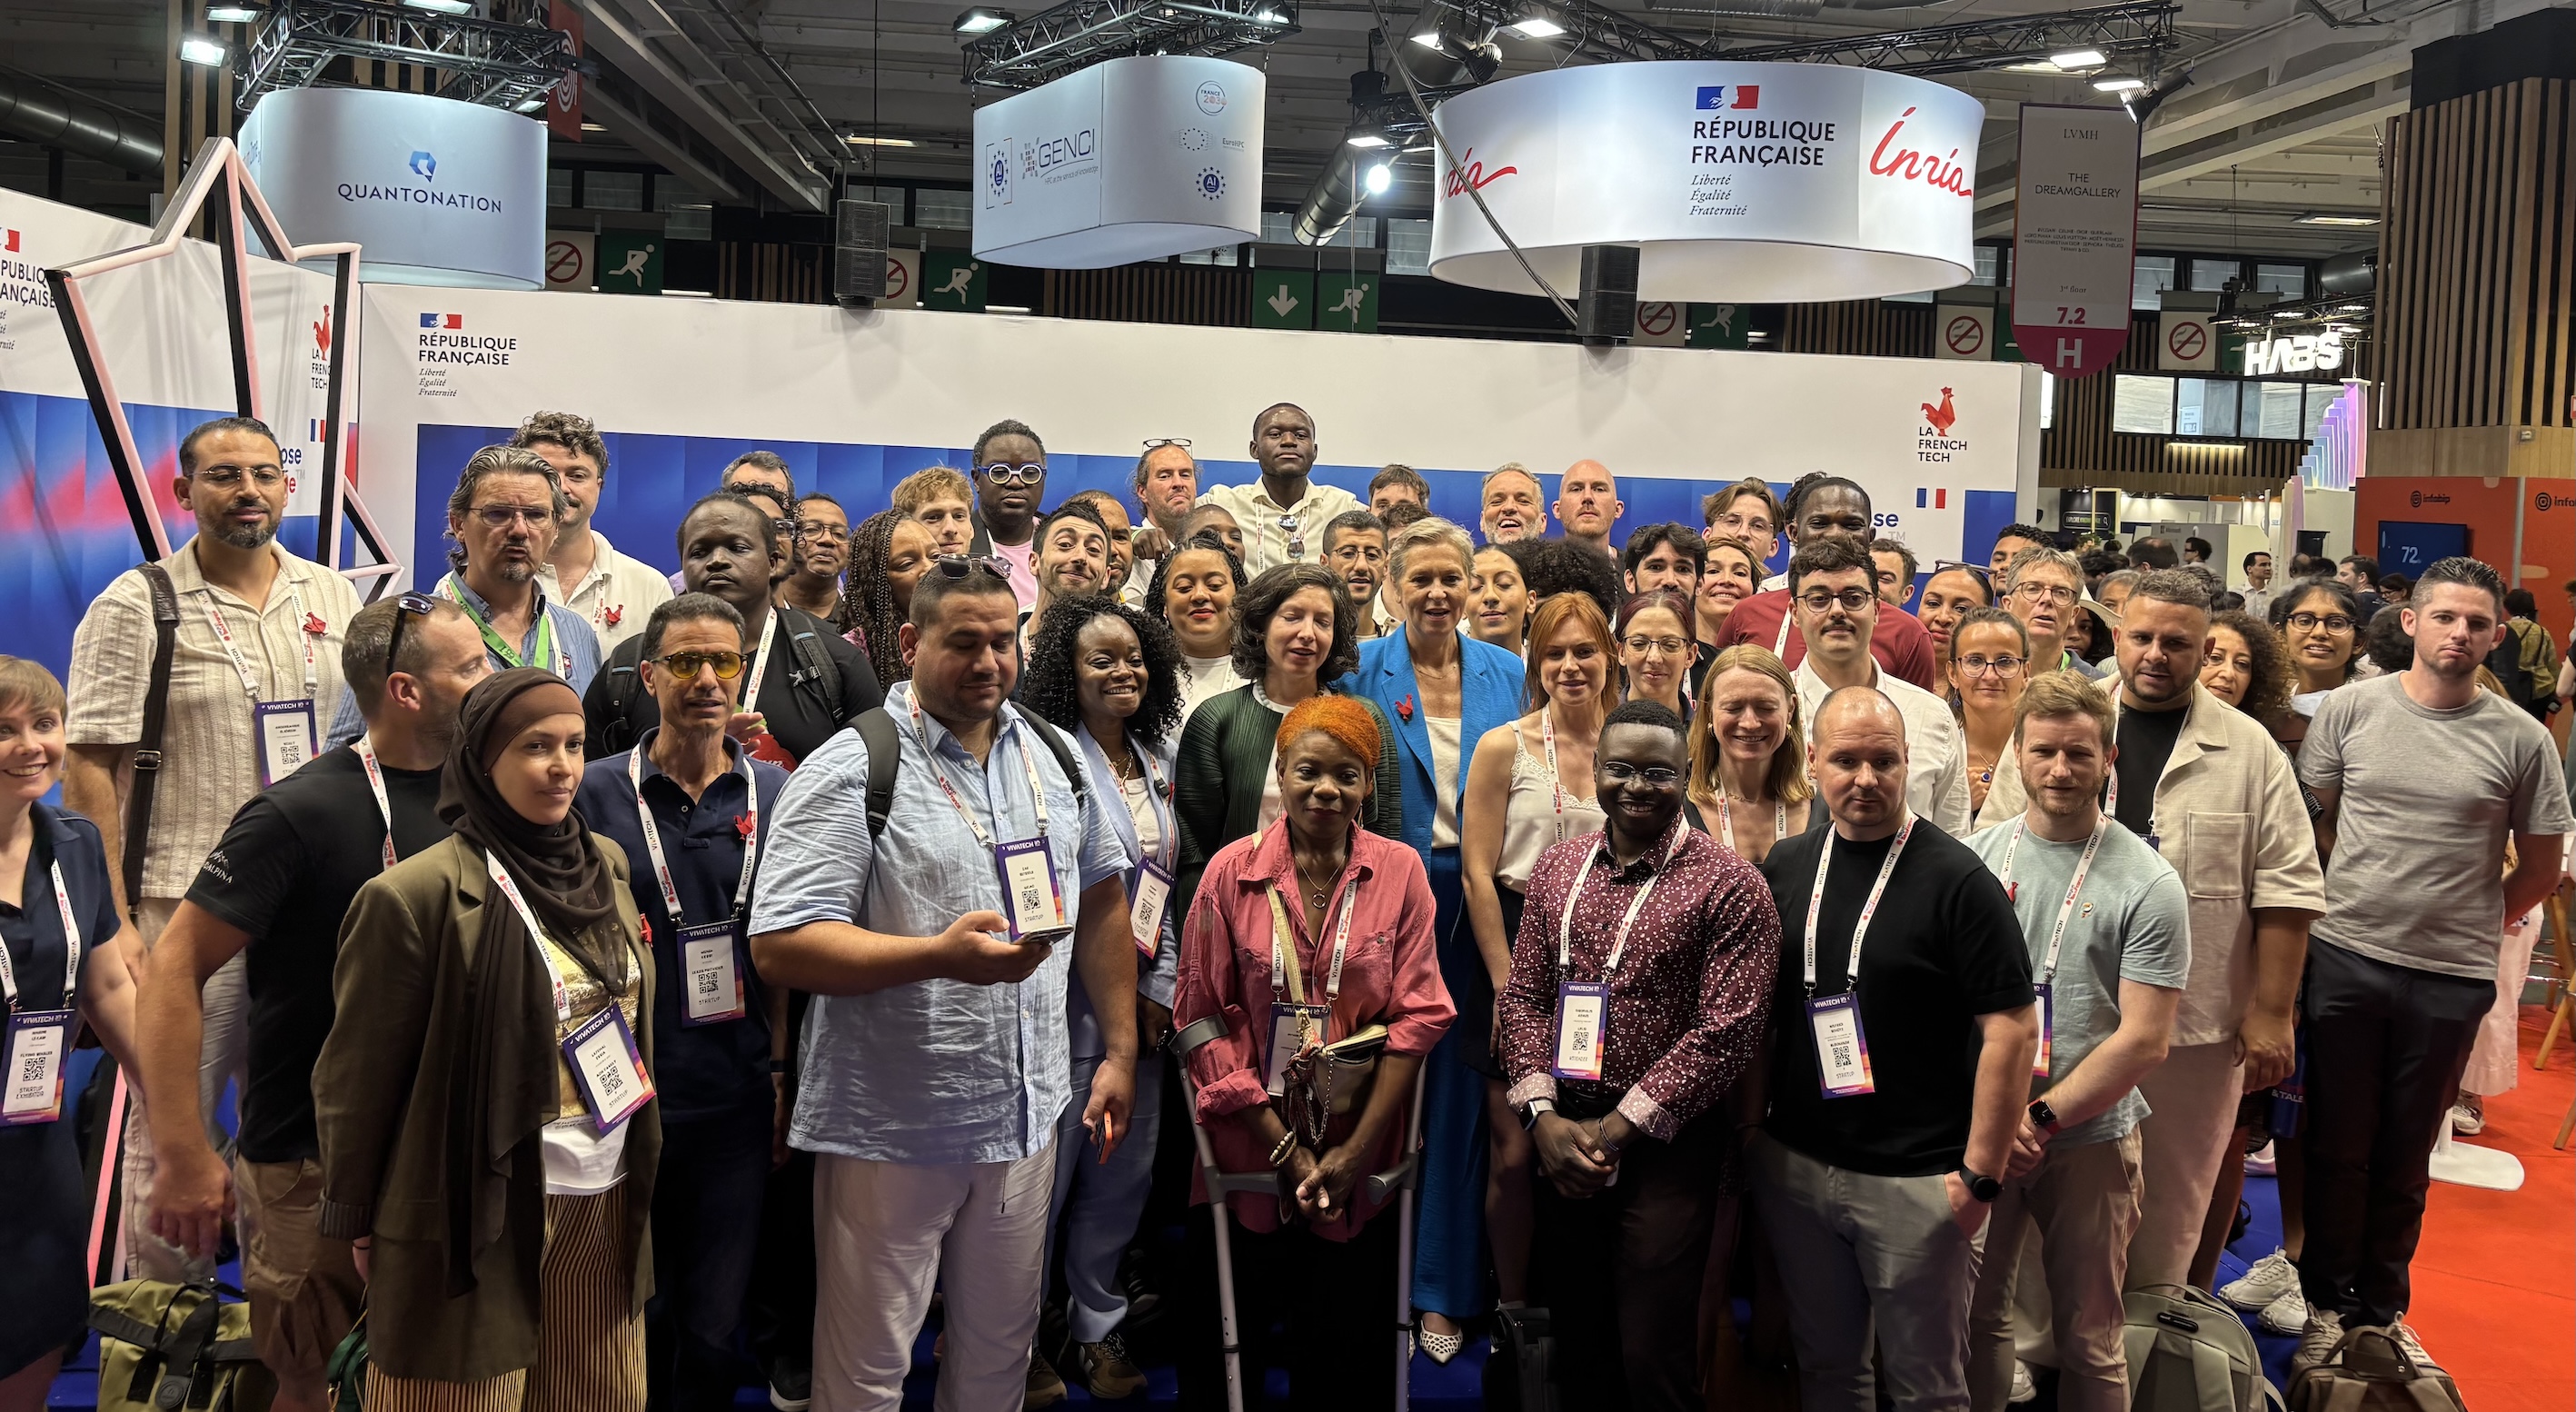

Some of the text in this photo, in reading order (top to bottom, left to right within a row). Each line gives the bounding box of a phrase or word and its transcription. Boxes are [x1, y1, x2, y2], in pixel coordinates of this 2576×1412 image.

[1693, 115, 1835, 144] RÉPUBLIQUE
[2064, 128, 2099, 140] LVMH
[1039, 128, 1095, 168] GENCI
[1691, 144, 1825, 167] FRANÇAISE
[1206, 176, 1217, 186] AI
[1691, 174, 1732, 185] Liberté
[2067, 173, 2090, 183] THE
[1690, 187, 1732, 204] Égalité
[2035, 184, 2121, 198] DREAMGALLERY
[338, 184, 502, 214] QUANTONATION
[1689, 204, 1747, 216] Fraternité
[1, 259, 47, 288] PUBLIQ
[2070, 285, 2086, 293] floor
[2057, 306, 2085, 324] 7.2
[419, 332, 517, 352] RÉPUBLIQUE
[312, 348, 320, 360] LA
[419, 350, 510, 366] FRANÇAISE
[2056, 337, 2083, 369] H
[419, 368, 447, 377] Liberté
[311, 377, 328, 390] TECH
[419, 377, 447, 387] Égalité
[418, 388, 458, 397] Fraternité
[1918, 426, 1934, 436] LA
[1918, 439, 1968, 451] FRENCH
[1917, 452, 1950, 462] TECH
[645, 820, 658, 850] VIVATECH
[1007, 842, 1034, 851] VIVATECH
[2084, 834, 2099, 860] VIVATECH
[741, 856, 752, 886] VIVATECH
[1148, 862, 1168, 879] VIVATECH
[689, 927, 721, 937] VIVATECH
[2052, 920, 2064, 948] VIVATECH
[1331, 949, 1342, 979] VIVATECH
[1814, 998, 1840, 1008] VIVATECH
[23, 1015, 55, 1024] VIVATECH
[574, 1018, 604, 1042] VIVATECH
[2272, 1089, 2279, 1098] &
